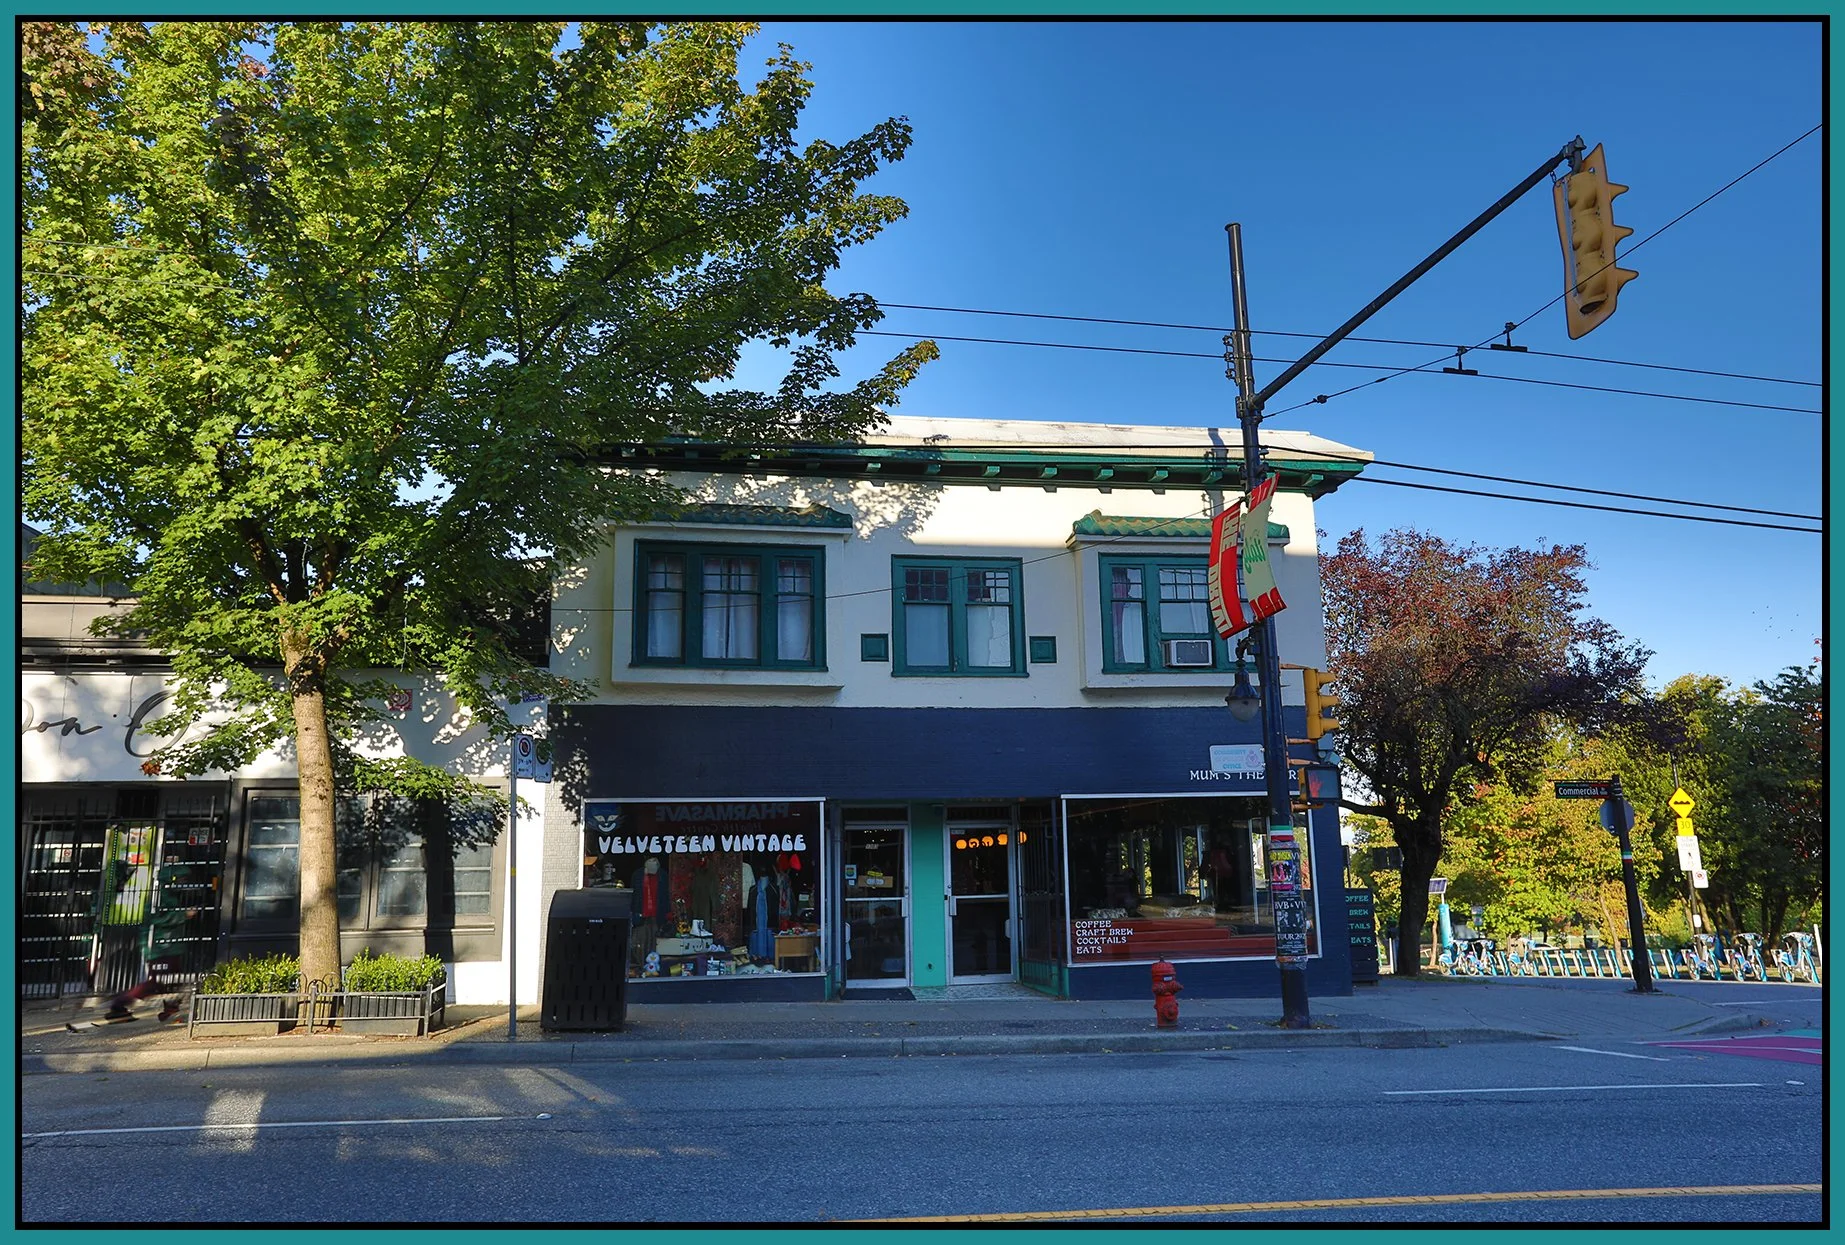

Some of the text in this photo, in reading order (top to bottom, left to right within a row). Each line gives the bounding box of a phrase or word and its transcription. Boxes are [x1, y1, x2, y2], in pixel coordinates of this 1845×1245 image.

[1190, 769, 1231, 780] MUMS
[1558, 786, 1599, 795] Commercial
[1680, 821, 1690, 829] 30
[598, 834, 807, 854] VELVETEEN VINTAGE
[1345, 895, 1369, 903] OFFEE
[1075, 920, 1112, 929] COFFEE
[1075, 928, 1134, 937] CRAFT BREW
[1076, 936, 1127, 945] COCKTAILS
[1350, 936, 1372, 944] EATS
[1076, 945, 1103, 954] EATS
